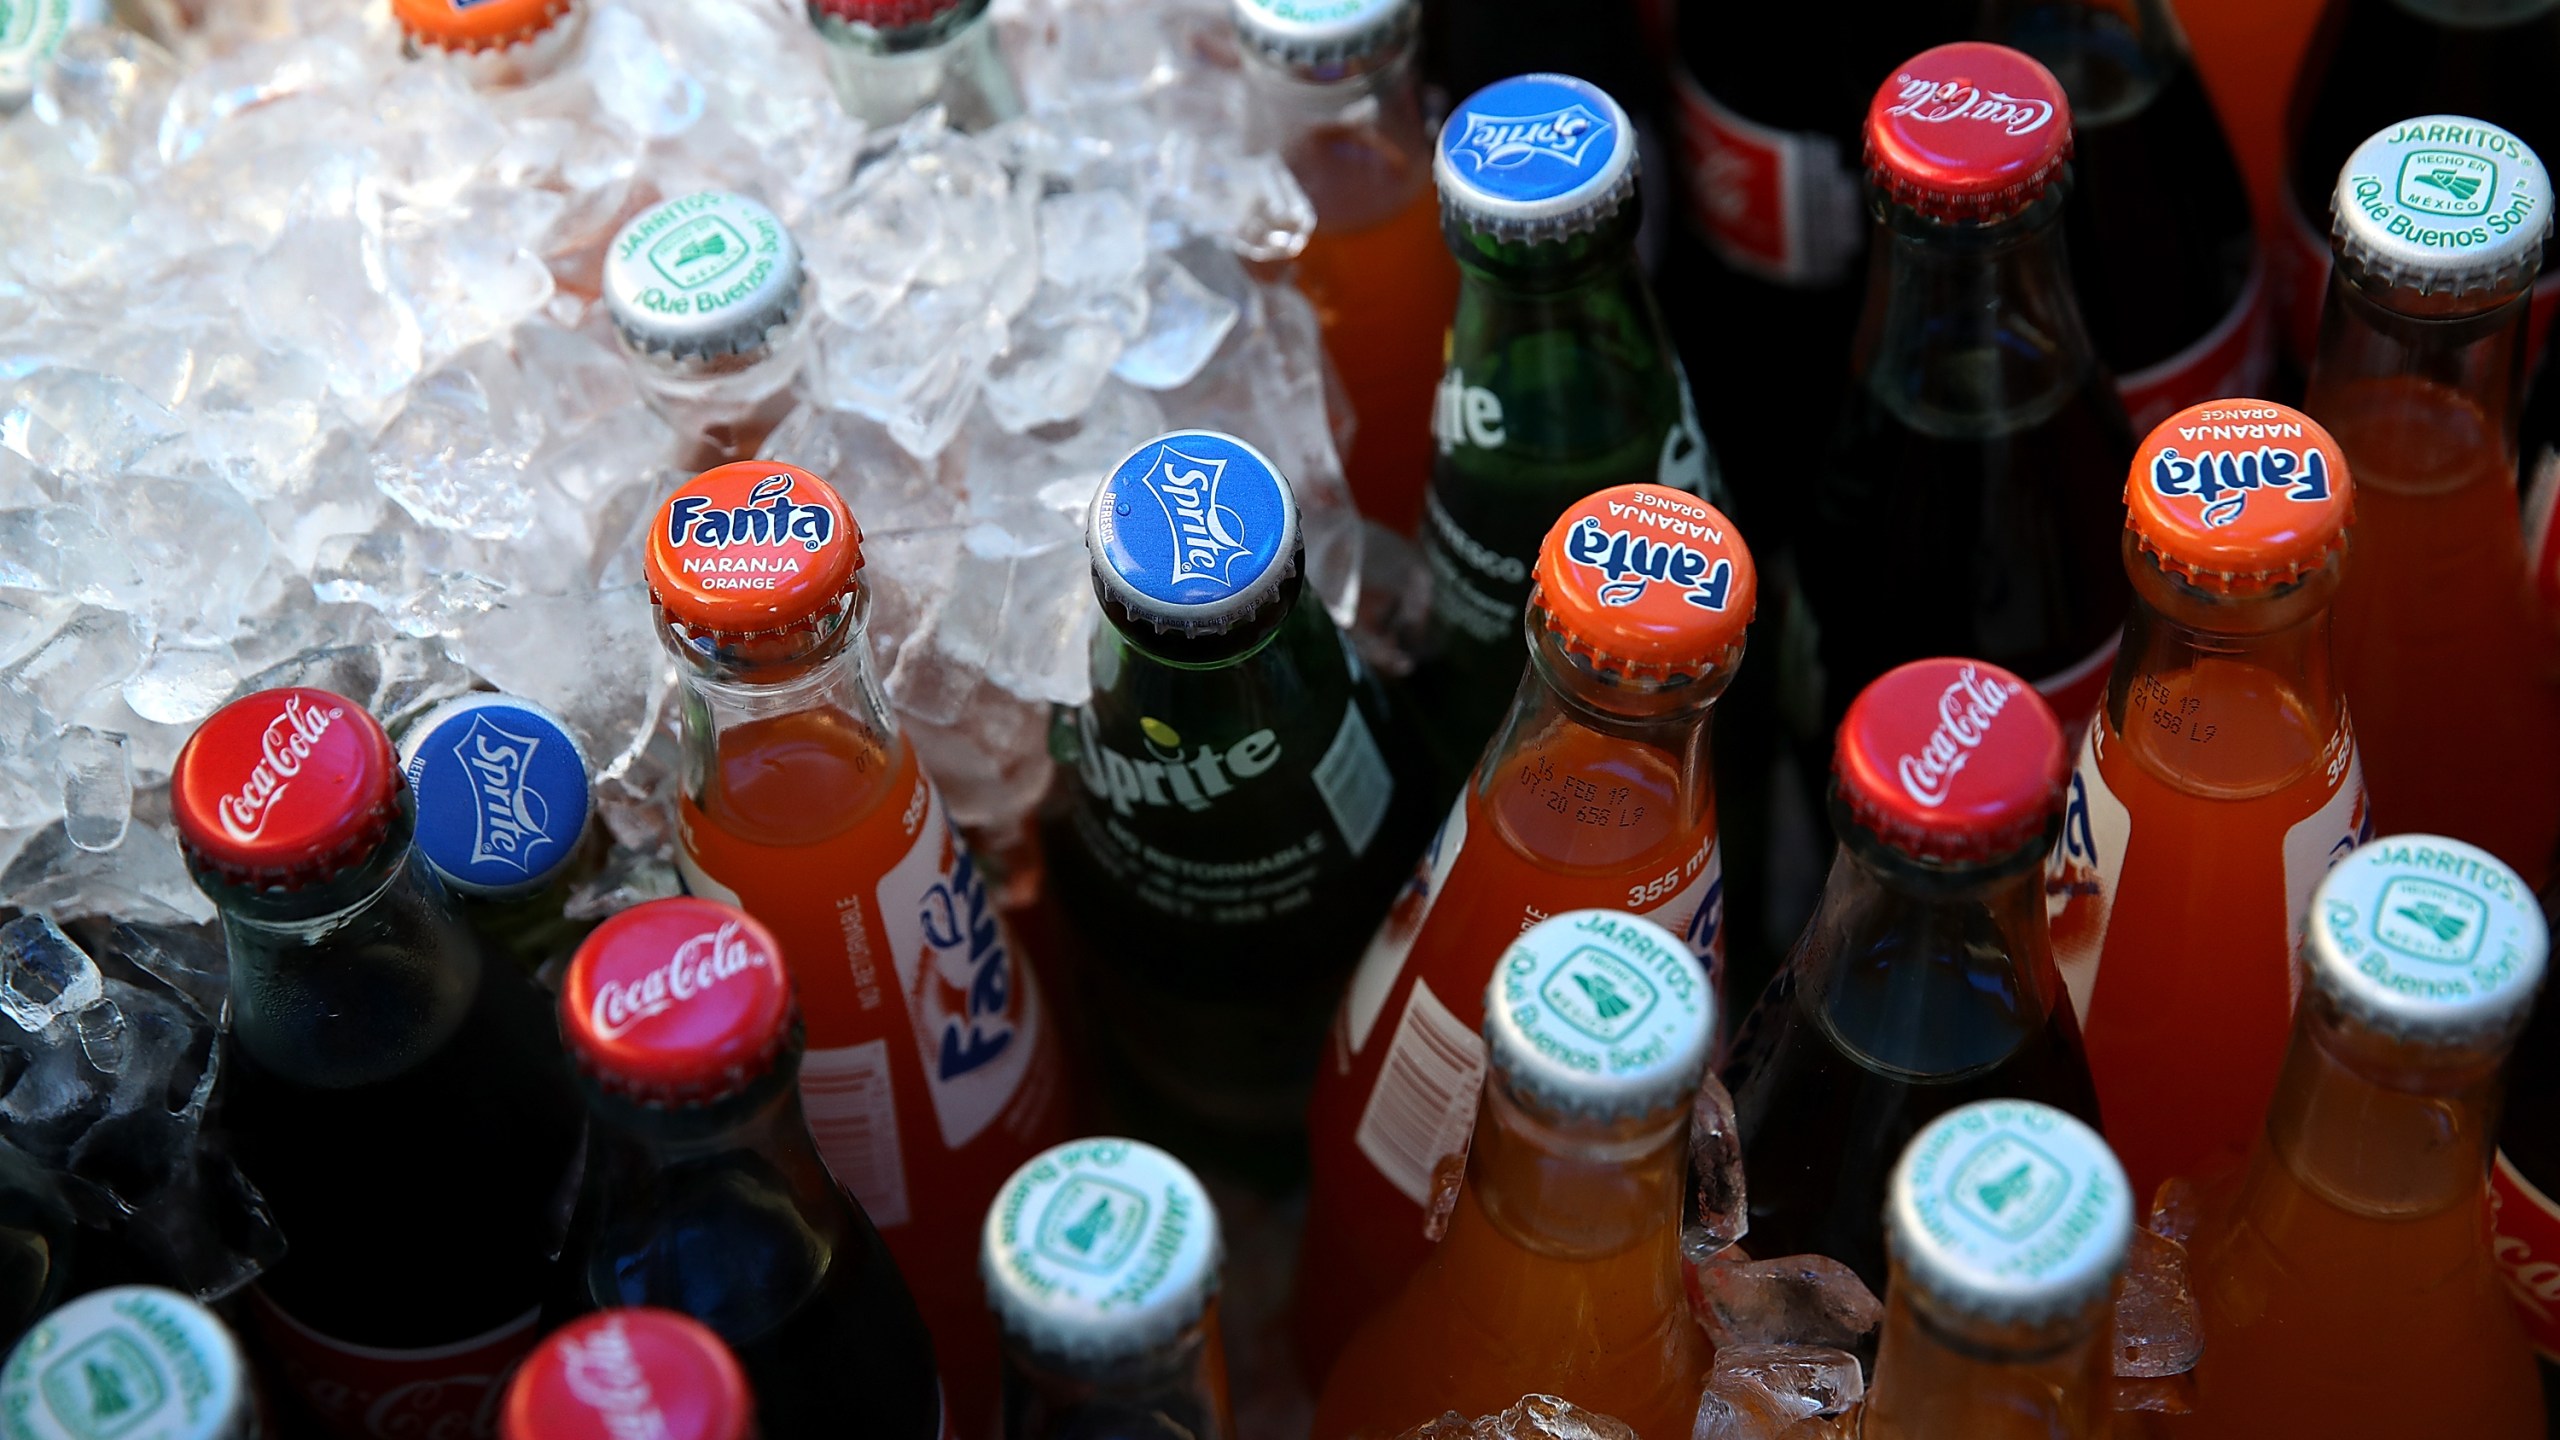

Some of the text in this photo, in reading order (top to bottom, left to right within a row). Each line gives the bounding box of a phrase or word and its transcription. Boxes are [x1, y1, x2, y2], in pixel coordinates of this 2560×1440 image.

[1472, 112, 1591, 153] Sprite
[1884, 78, 2054, 136] Coca-Cola
[2388, 123, 2521, 160] JARRITOS
[2417, 154, 2487, 172] HECHO EN
[617, 191, 722, 263] JARRITOS
[2352, 175, 2536, 248] ¡Qué Buenos Son!
[2407, 193, 2479, 210] MÉXICO
[696, 258, 773, 313] Buenos
[2178, 423, 2302, 442] NARANJA
[2201, 408, 2279, 422] ORANGE
[2151, 447, 2331, 503] Fanta
[669, 496, 834, 552] Fanta
[1100, 491, 1118, 544] REFRESCO
[1160, 462, 1230, 569] Sprite
[1608, 500, 1723, 545] NARANJA
[1633, 491, 1706, 520] ORANGE
[683, 557, 800, 573] NARANJA
[701, 577, 776, 590] ORANGE
[1564, 517, 1732, 612] Fanta
[2145, 674, 2171, 706] FEB
[1078, 705, 1282, 817] Sprite
[1898, 662, 2010, 808] Coca-Cola
[219, 692, 330, 843] Coca-Cola
[471, 735, 531, 853] Sprite
[1564, 775, 1598, 803] FEB
[1576, 806, 1611, 826] 658
[1619, 806, 1645, 827] L9
[1627, 835, 1713, 907] 355 mL
[2370, 844, 2517, 902] JARRITOS
[591, 919, 749, 1042] Coca-Cola
[1573, 914, 1698, 1001] JARRITOS
